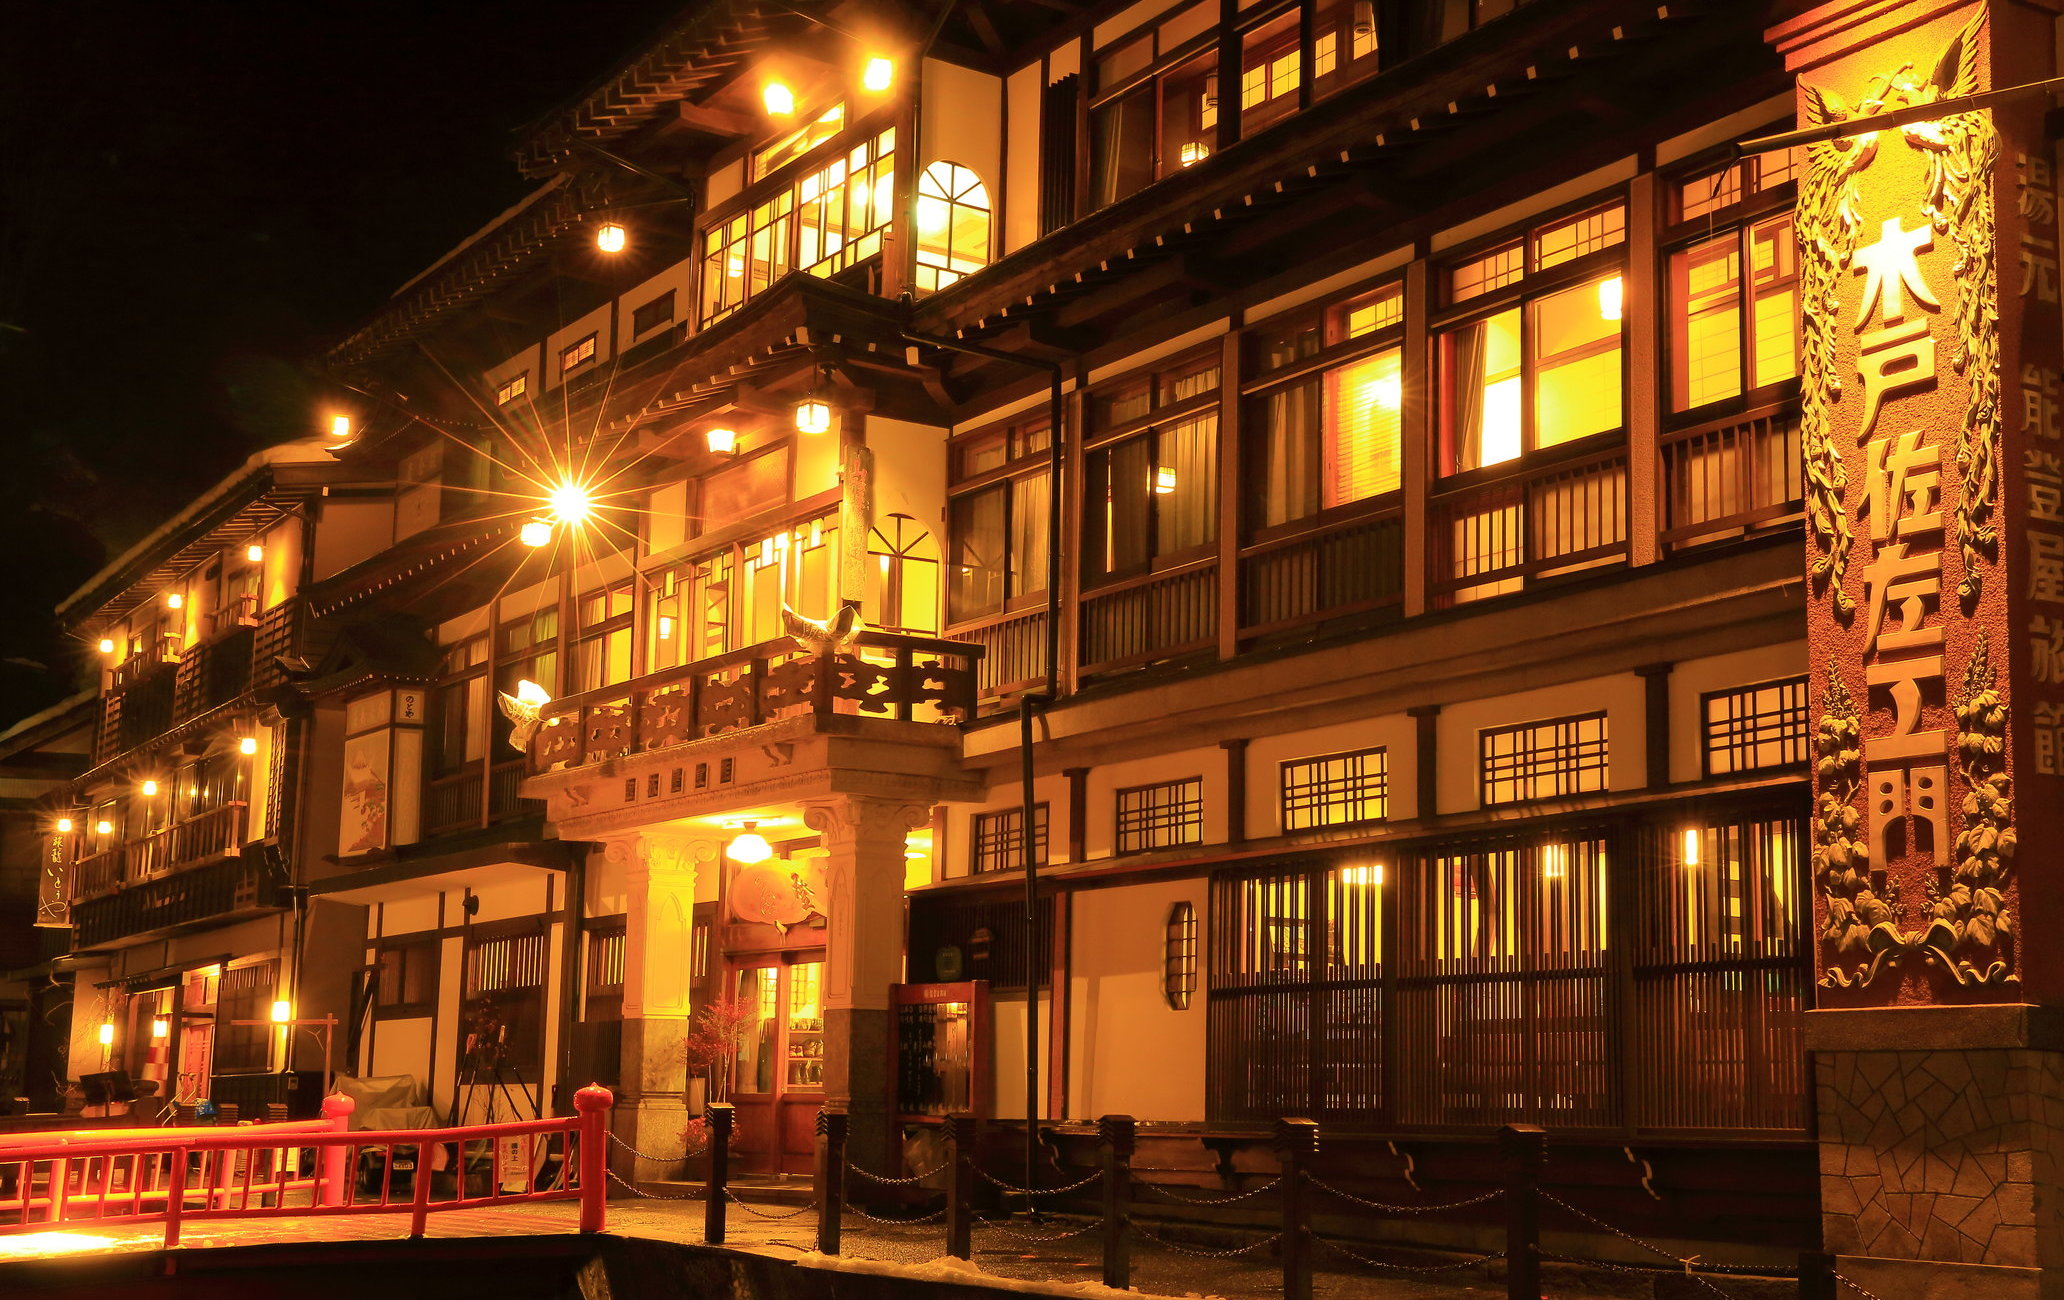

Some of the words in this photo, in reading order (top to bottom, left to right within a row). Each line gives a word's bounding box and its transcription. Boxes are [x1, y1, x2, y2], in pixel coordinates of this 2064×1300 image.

[2016, 152, 2058, 303] 湯元
[405, 695, 414, 719] のとや
